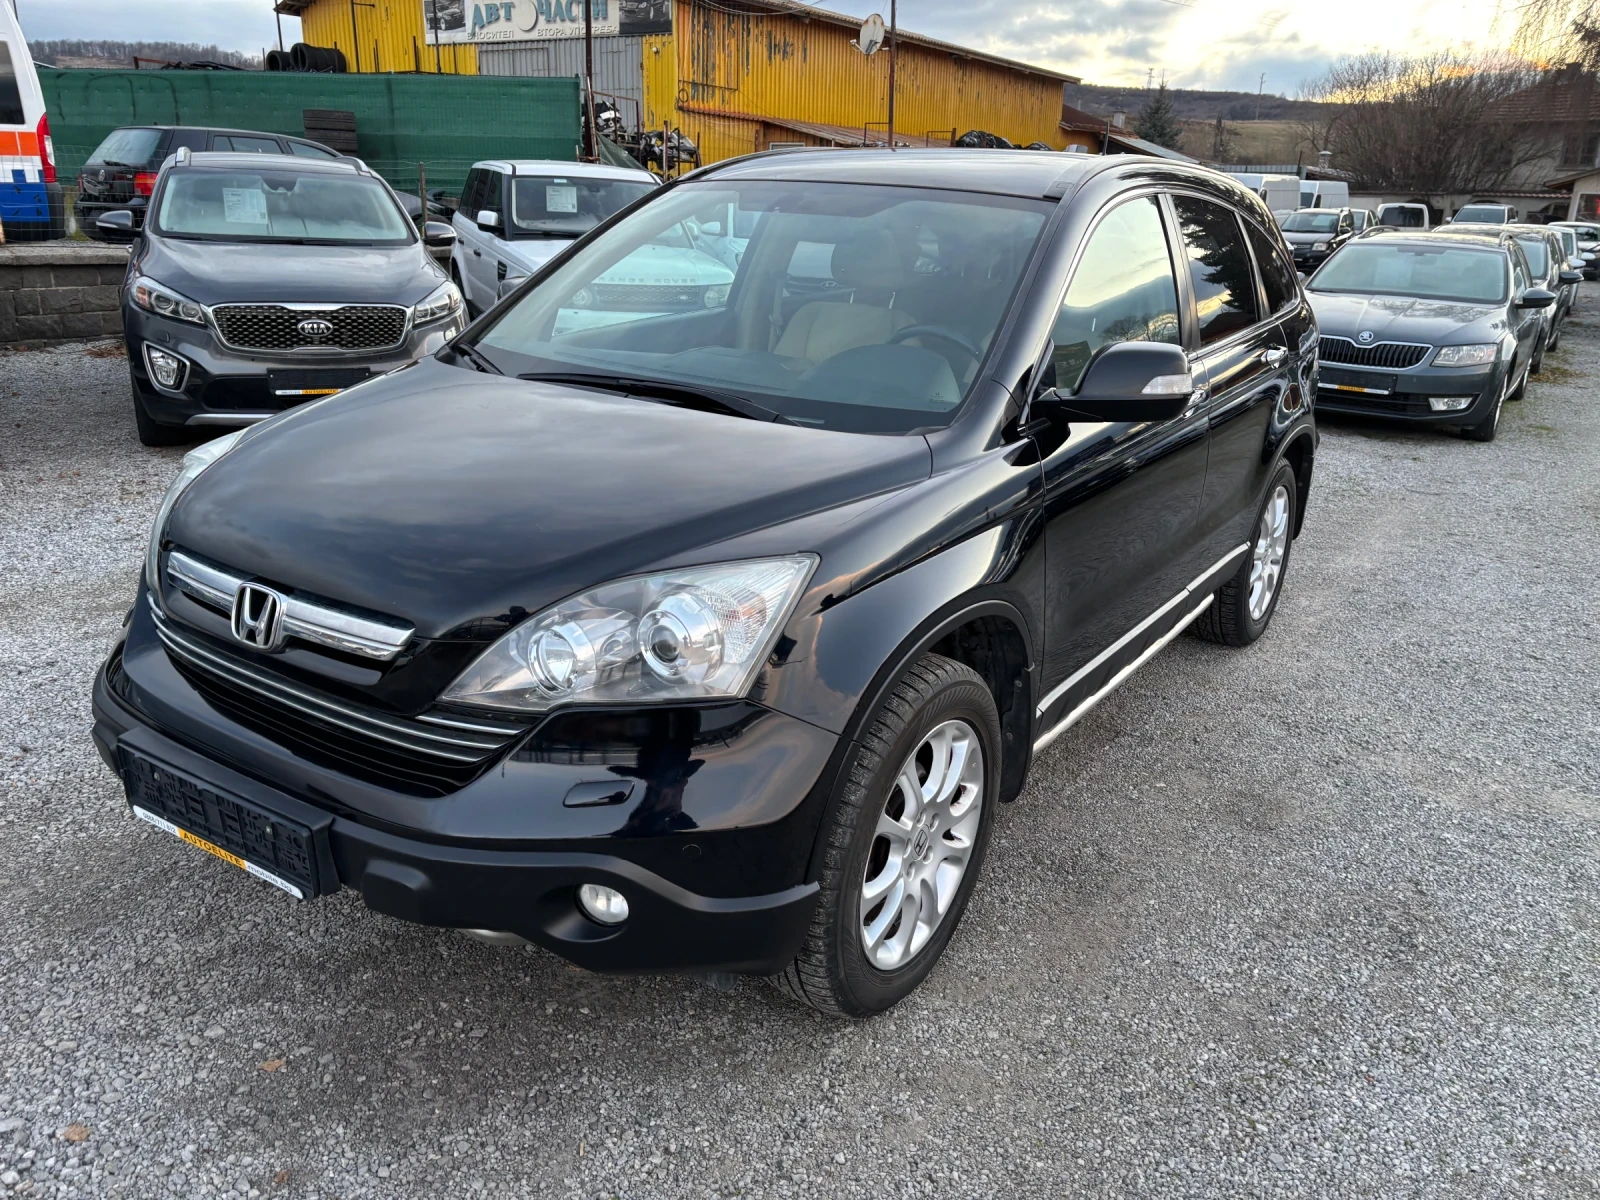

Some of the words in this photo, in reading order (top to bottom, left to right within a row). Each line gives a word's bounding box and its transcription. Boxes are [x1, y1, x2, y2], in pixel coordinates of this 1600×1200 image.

[537, 27, 567, 37] ВТОРА
[304, 323, 328, 333] KIA
[184, 832, 242, 866] AUTOELITE
